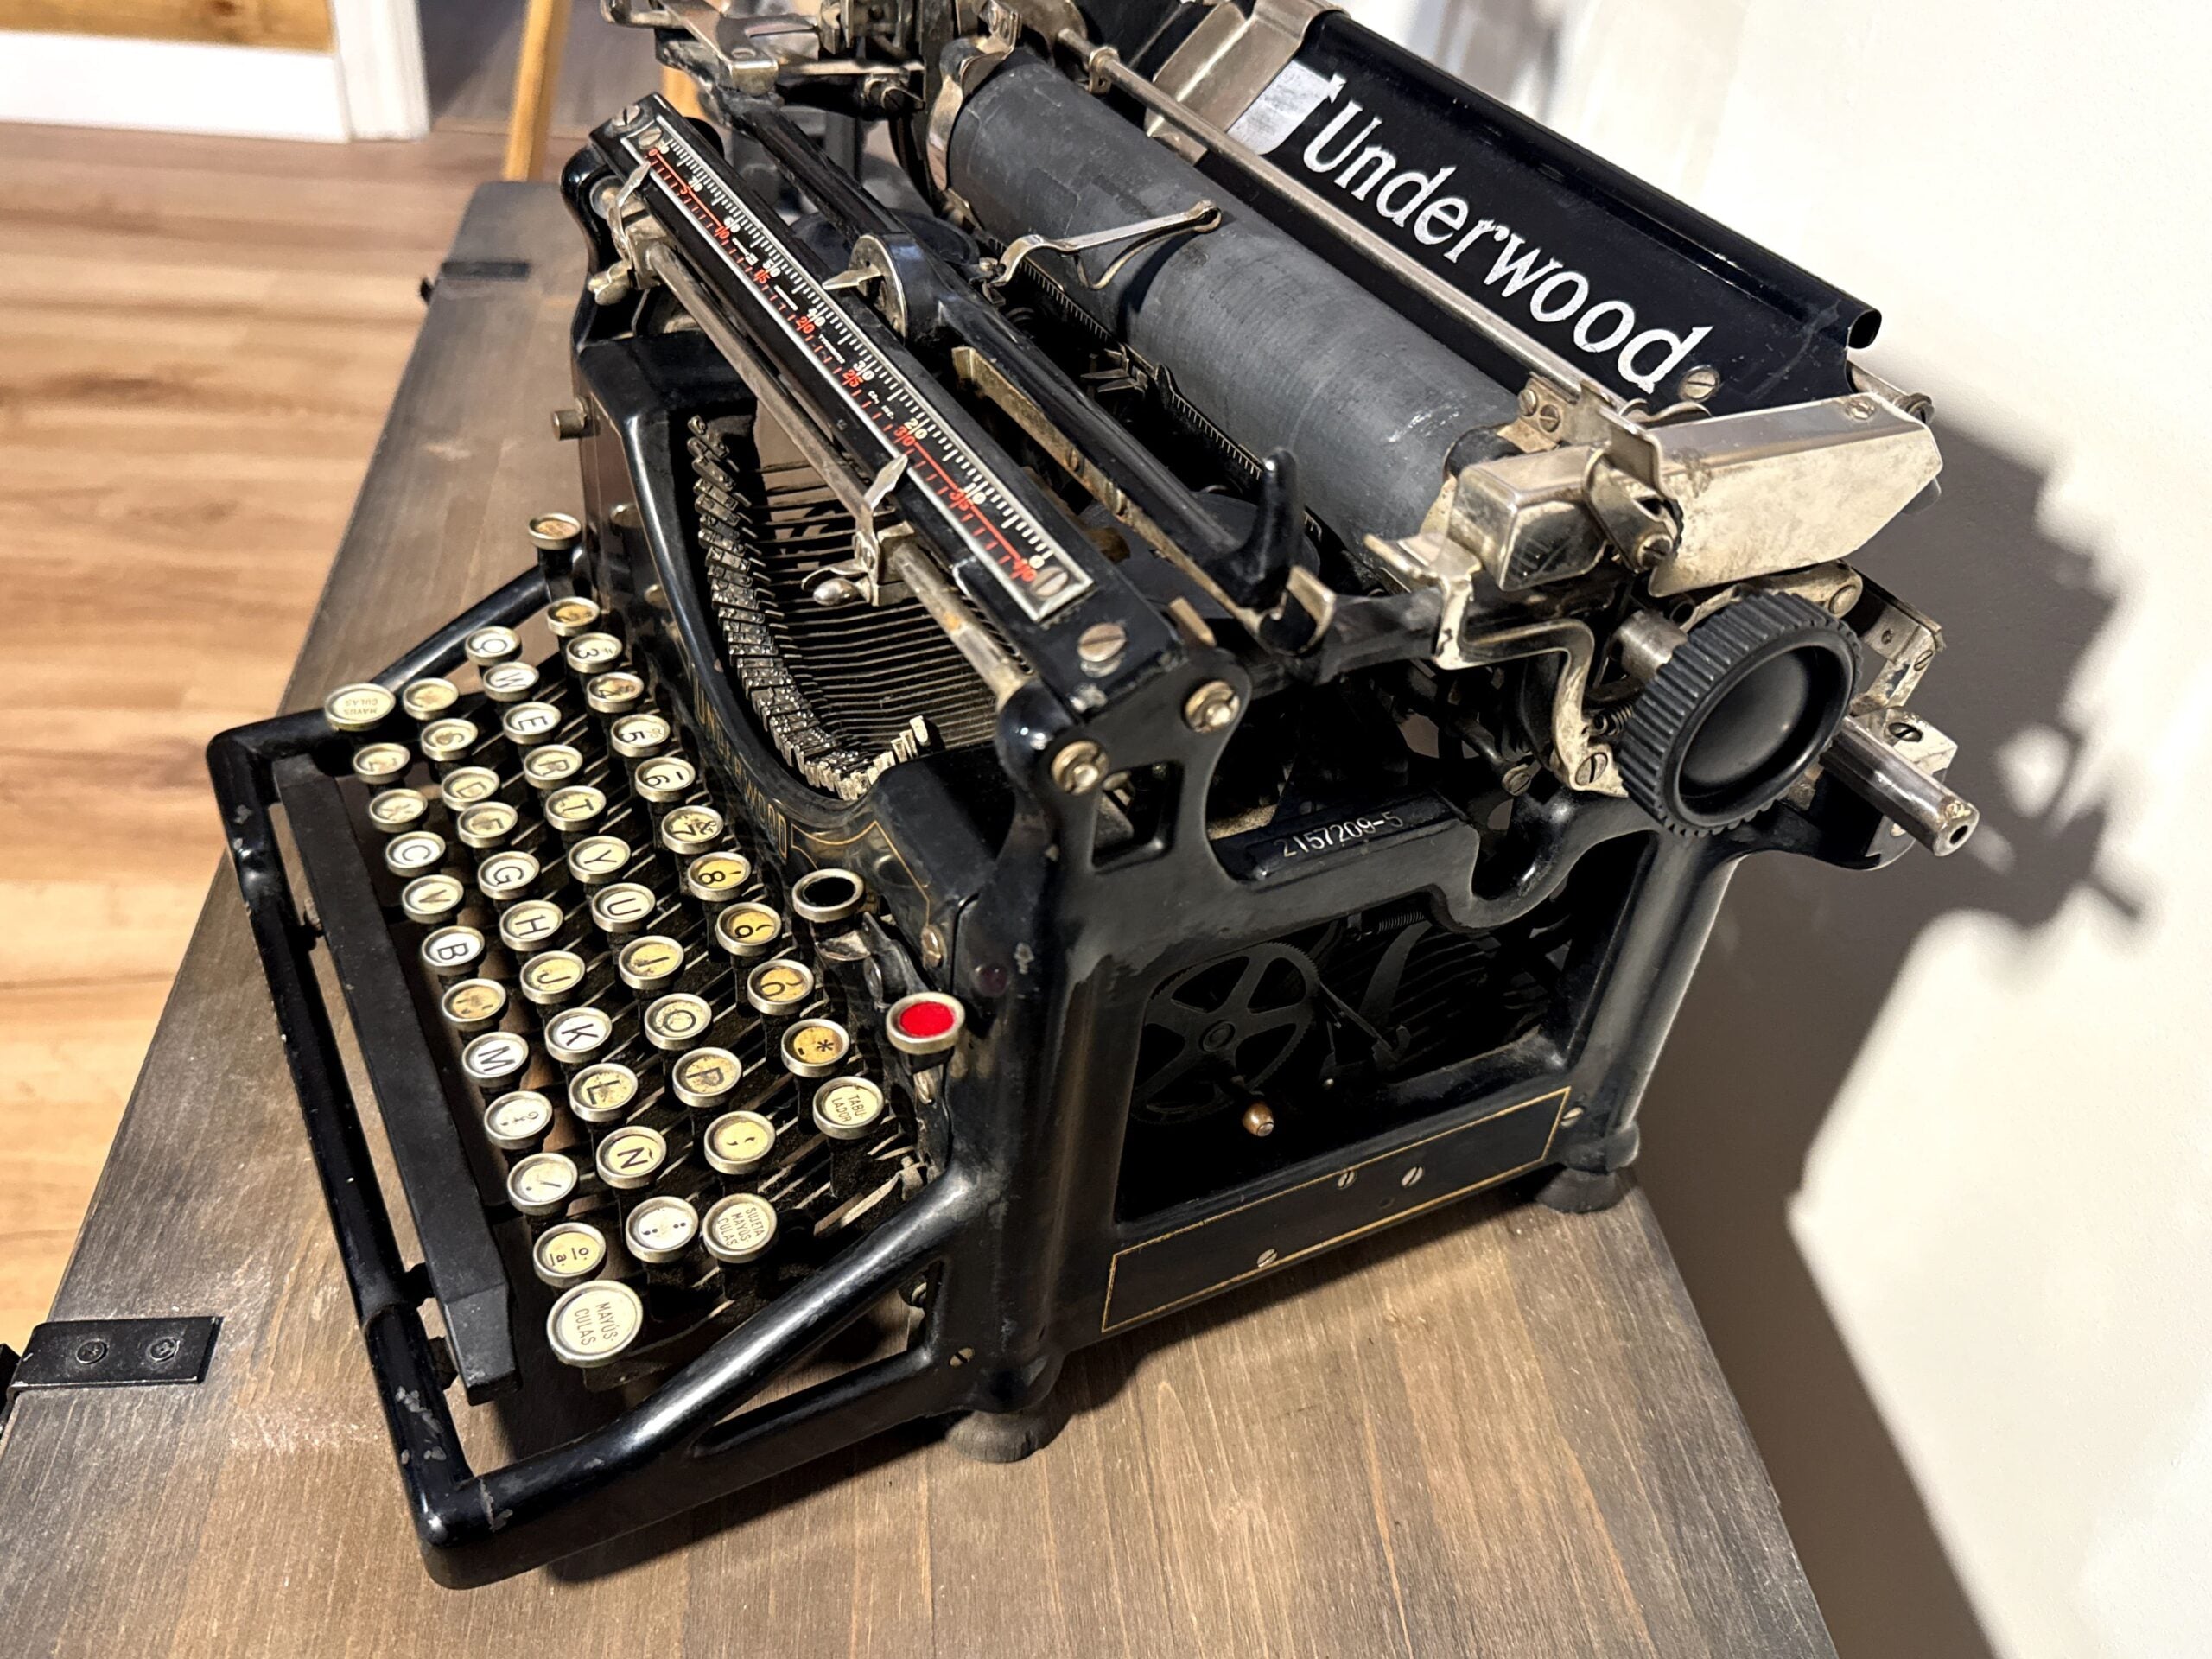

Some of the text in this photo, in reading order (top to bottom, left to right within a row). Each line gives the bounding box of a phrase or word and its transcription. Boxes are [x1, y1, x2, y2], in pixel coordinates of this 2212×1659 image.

[688, 177, 703, 192] 70
[715, 226, 730, 239] 10
[723, 217, 741, 233] 60
[1303, 99, 1713, 393] Underwood
[753, 268, 770, 284] 15
[762, 260, 780, 277] 50
[795, 316, 815, 334] 20
[807, 308, 825, 327] 40
[842, 369, 864, 387] 25
[853, 359, 874, 381] 30
[894, 425, 916, 447] 30
[904, 417, 928, 440] 20
[950, 492, 971, 511] 35
[963, 482, 986, 505] 10
[1029, 555, 1045, 569] 0
[475, 638, 508, 654] Q
[577, 648, 599, 659] 3
[496, 671, 527, 689] W
[518, 715, 549, 731] E
[435, 732, 465, 747] S
[622, 730, 646, 743] 5
[538, 759, 570, 777] R
[647, 774, 671, 787] 6
[456, 781, 488, 799] D
[562, 798, 594, 813] T
[672, 823, 697, 836] 7
[696, 819, 718, 836] &
[1274, 811, 1404, 857] 2157209-5
[402, 844, 432, 861] C
[583, 849, 618, 864] Y
[493, 866, 524, 886] G
[698, 870, 726, 885] 8
[418, 889, 452, 904] V
[607, 898, 642, 916] U
[515, 914, 550, 937] H
[734, 924, 754, 938] 9
[437, 942, 469, 961] B
[637, 956, 671, 968] I
[537, 971, 572, 984] J
[663, 1009, 697, 1033] O
[561, 1023, 600, 1046] K
[478, 1046, 516, 1072] M
[686, 1066, 725, 1087] P
[587, 1080, 621, 1105] L
[831, 1097, 853, 1122] LADOR
[617, 1147, 654, 1169] Ñ
[746, 1207, 766, 1237] SUJETA
[717, 1217, 739, 1247] CULAS
[574, 1307, 597, 1346] CULAS
